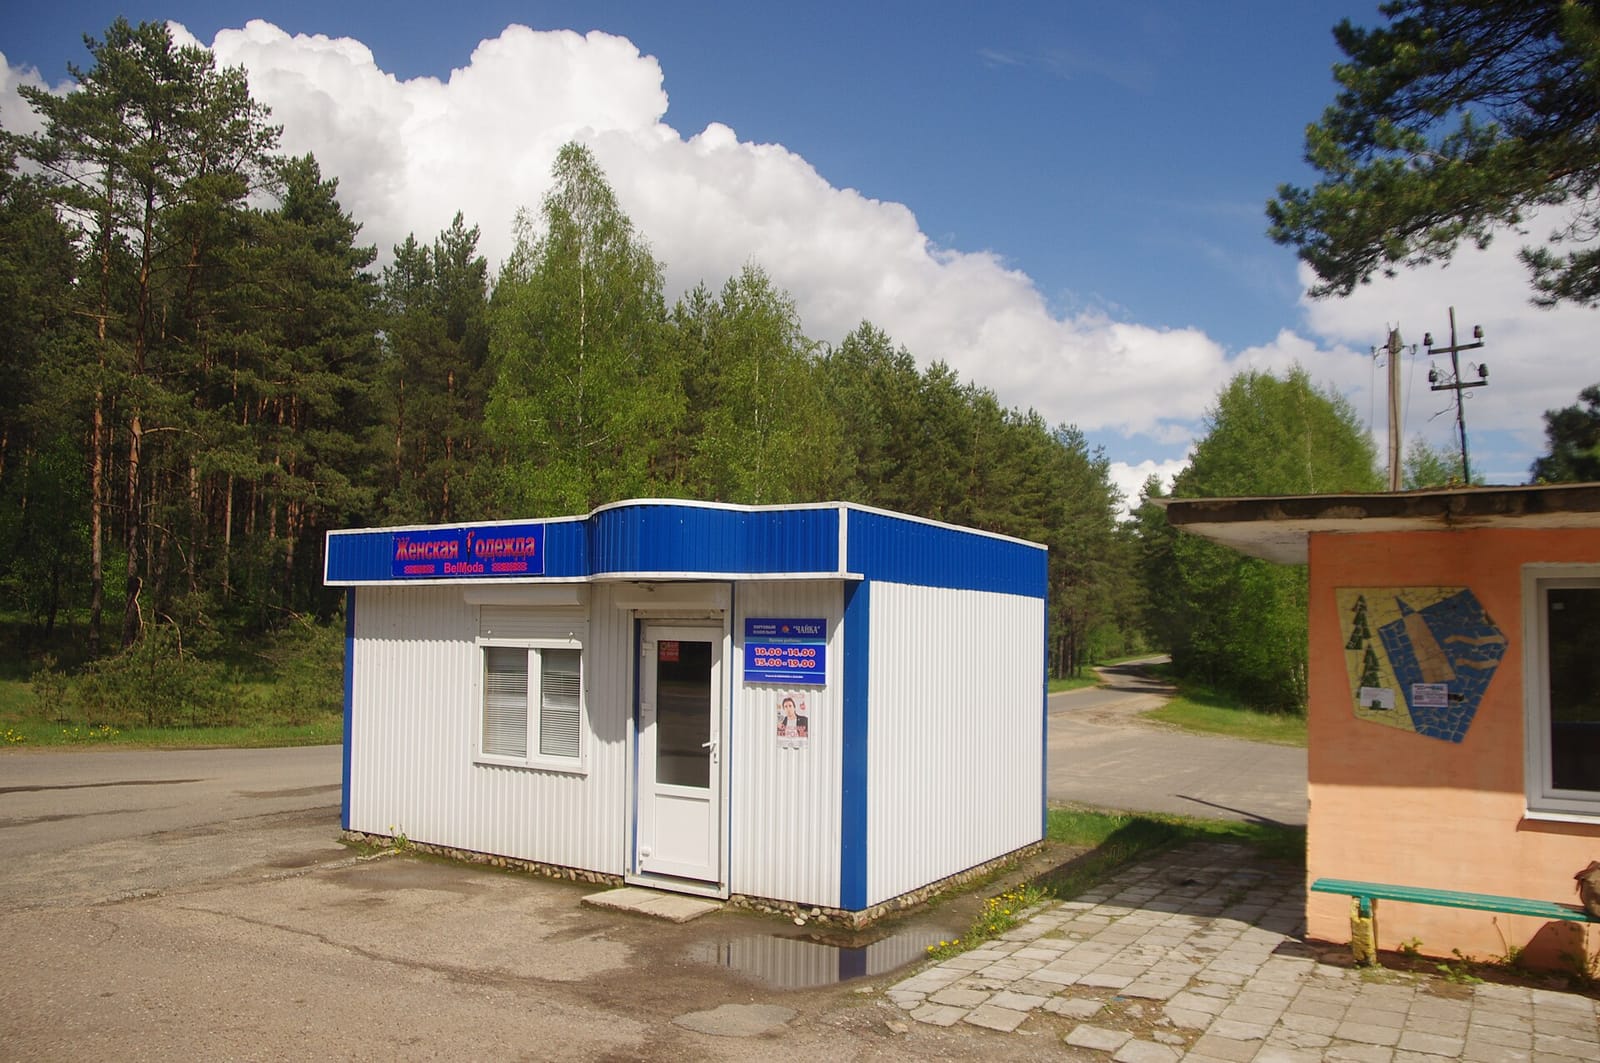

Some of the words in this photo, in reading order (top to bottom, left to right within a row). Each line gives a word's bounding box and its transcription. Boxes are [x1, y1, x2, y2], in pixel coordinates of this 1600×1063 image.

[395, 537, 459, 561] Женская
[475, 537, 536, 562] одежда
[443, 562, 485, 574] BelModa
